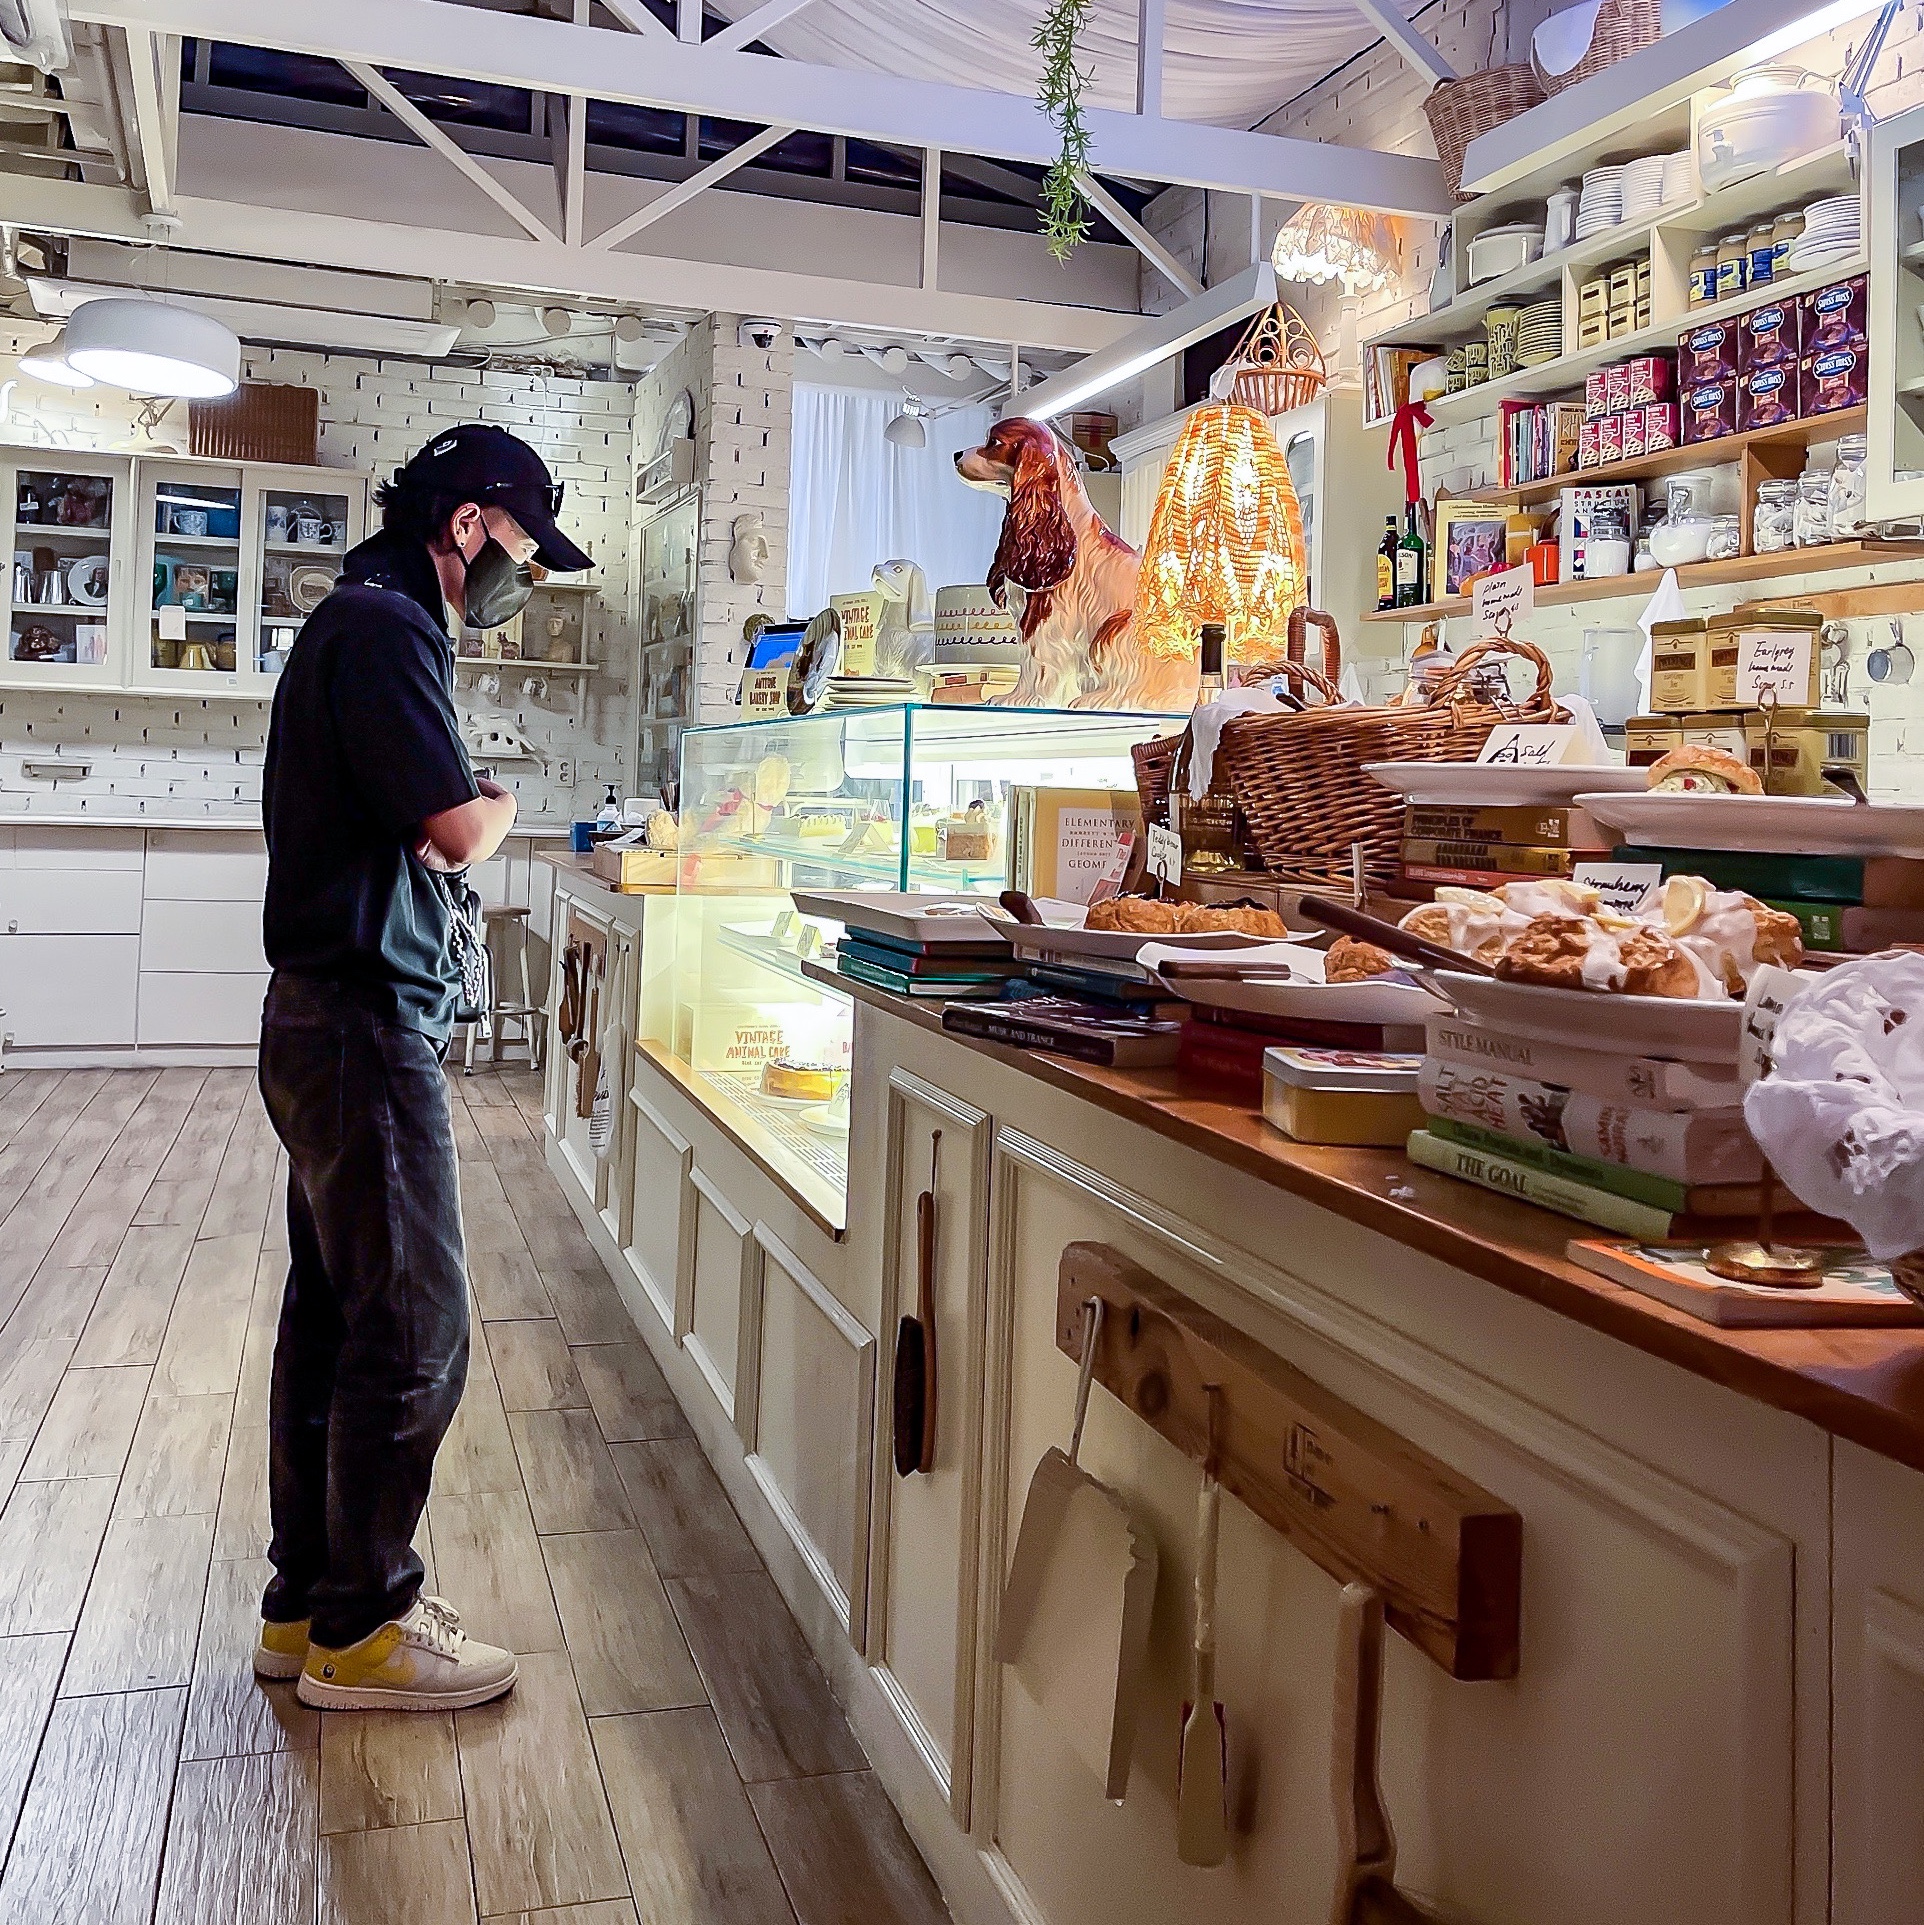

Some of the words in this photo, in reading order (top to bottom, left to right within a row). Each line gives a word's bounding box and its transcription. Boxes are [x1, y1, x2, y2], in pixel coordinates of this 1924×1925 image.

[1574, 488, 1630, 499] PASCAL
[1065, 817, 1135, 829] ELEMENTARY
[735, 1030, 784, 1045] VINTAGE
[1010, 1028, 1026, 1042] AND
[1456, 1153, 1485, 1179] THE
[1487, 1165, 1529, 1194] GOAL
